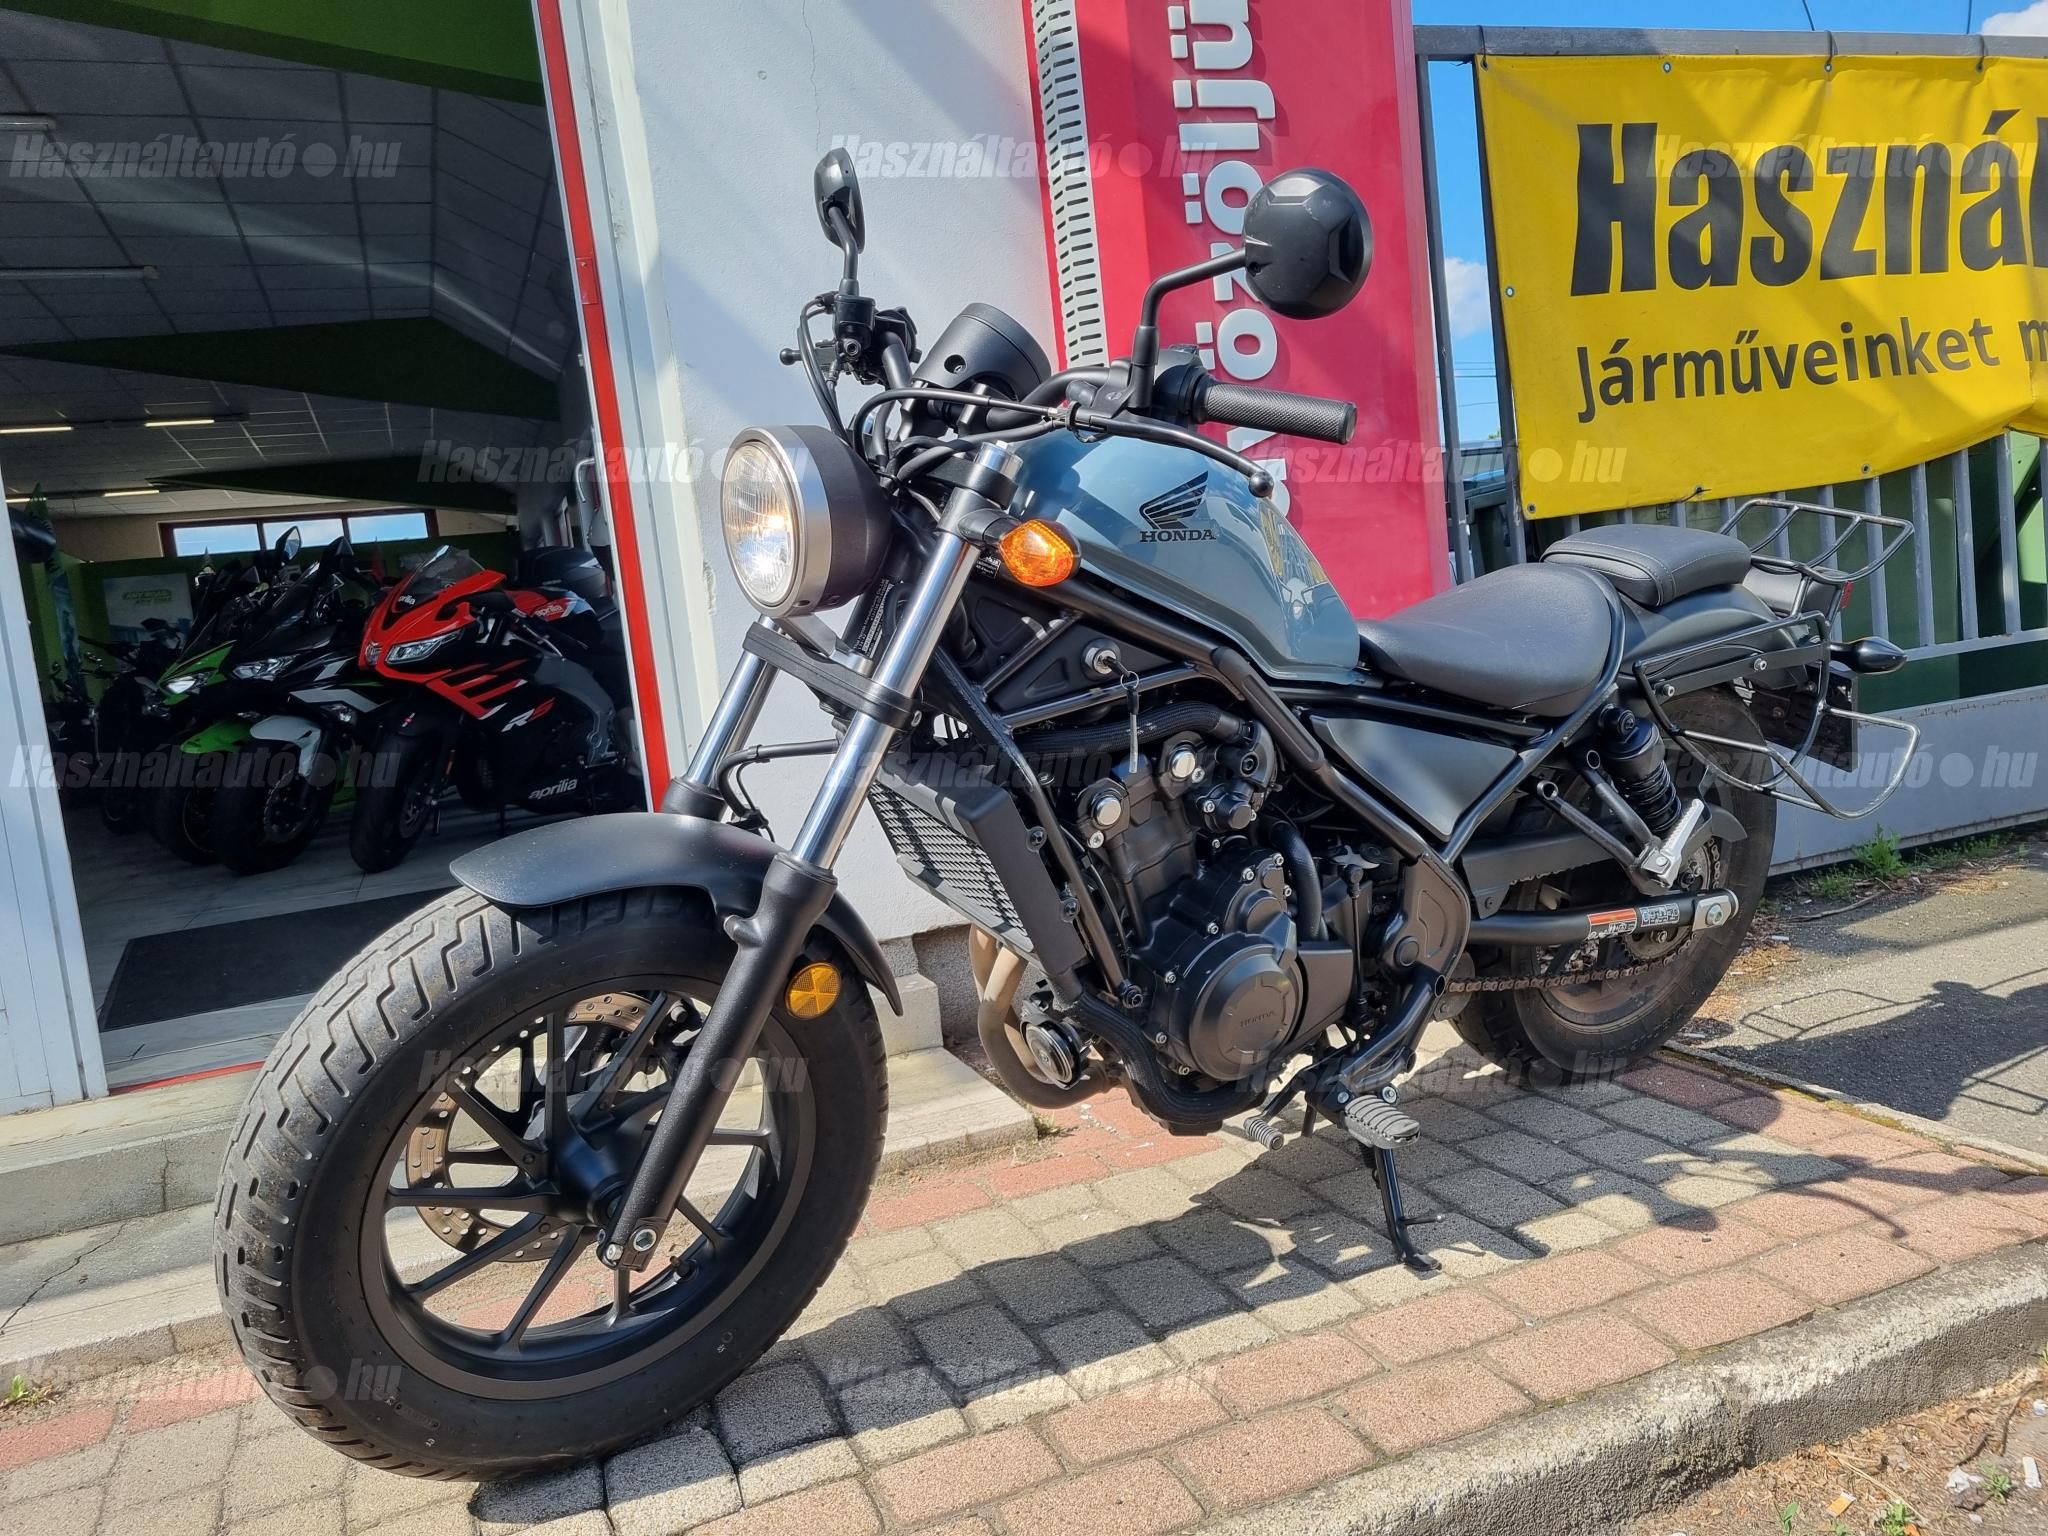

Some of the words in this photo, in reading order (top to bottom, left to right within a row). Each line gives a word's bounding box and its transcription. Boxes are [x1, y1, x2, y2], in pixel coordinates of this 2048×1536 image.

[1577, 316, 2000, 423] Járműveinket
[1139, 529, 1216, 543] HONDA
[528, 778, 578, 800] aprilia
